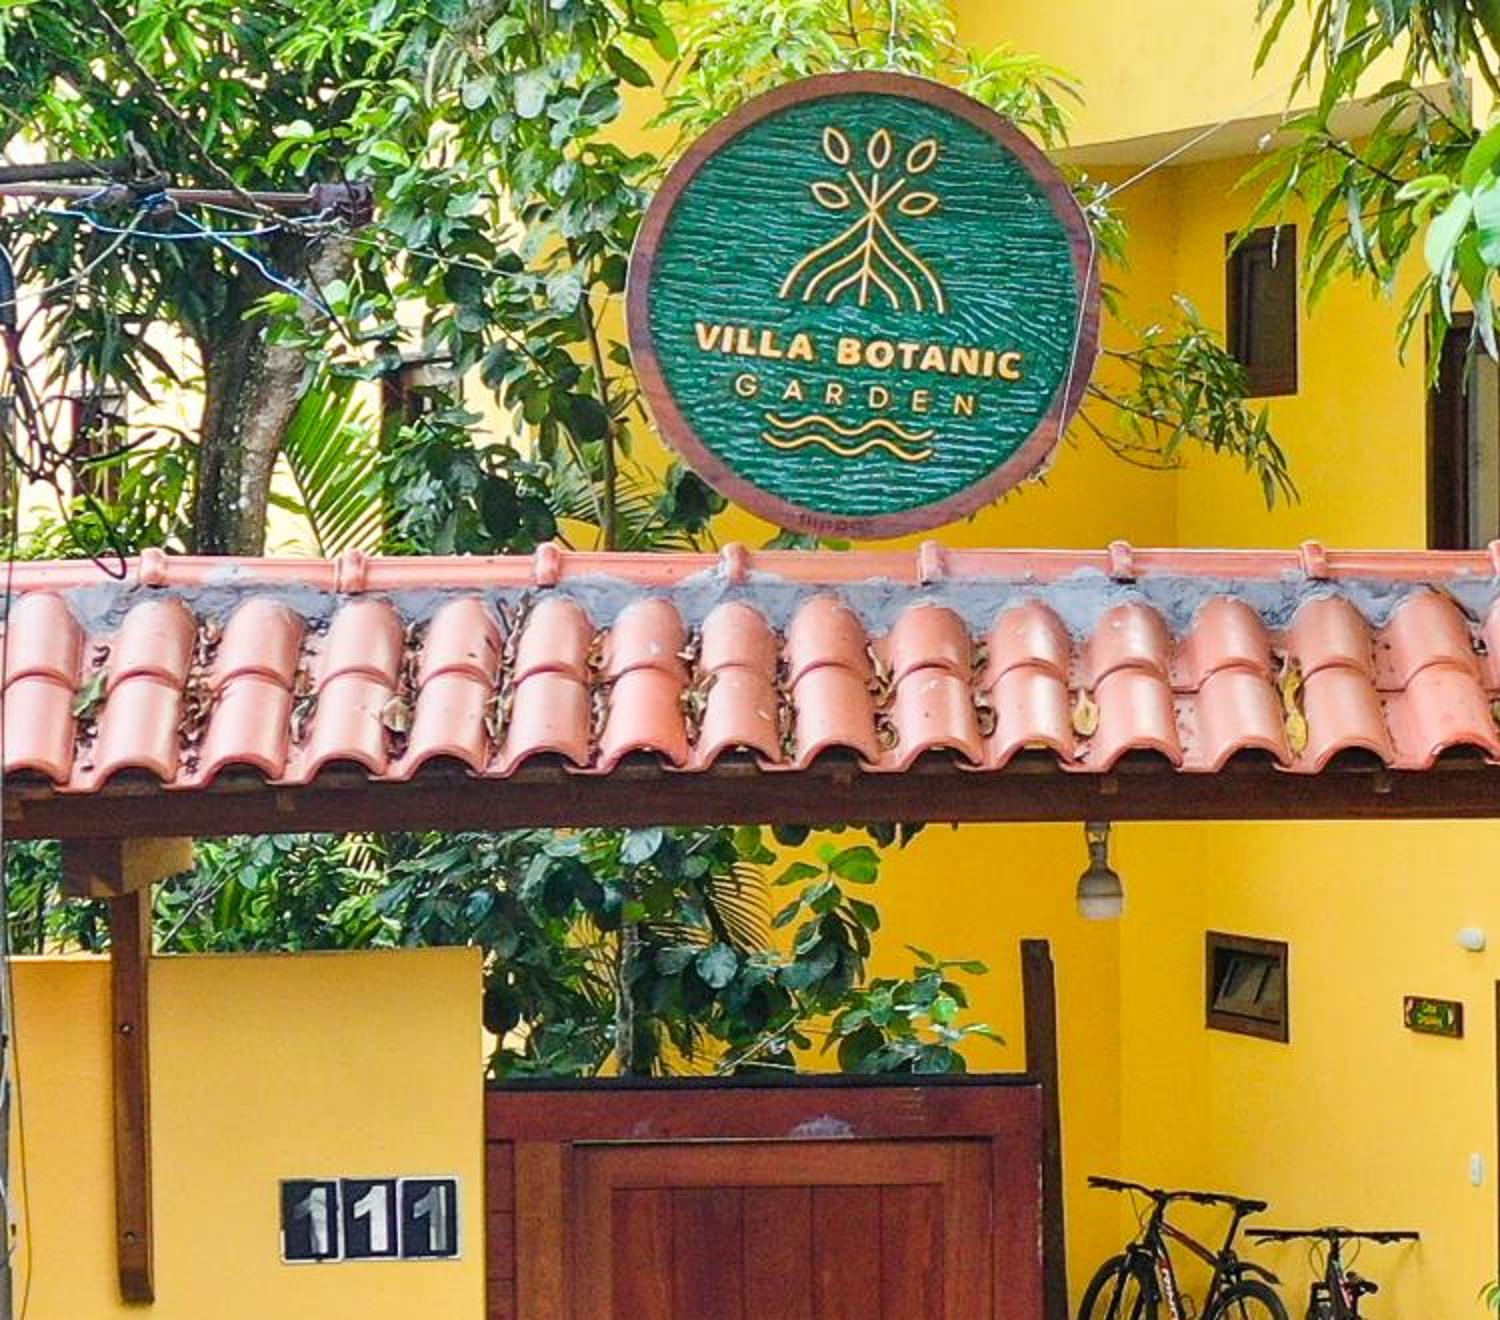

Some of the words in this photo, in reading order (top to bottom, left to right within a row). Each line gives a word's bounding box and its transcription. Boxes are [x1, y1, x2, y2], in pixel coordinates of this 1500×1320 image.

[695, 323, 814, 361] VILLA
[836, 337, 1022, 380] BOTANIC
[735, 373, 974, 416] GARDEN
[294, 1185, 446, 1253] 111
